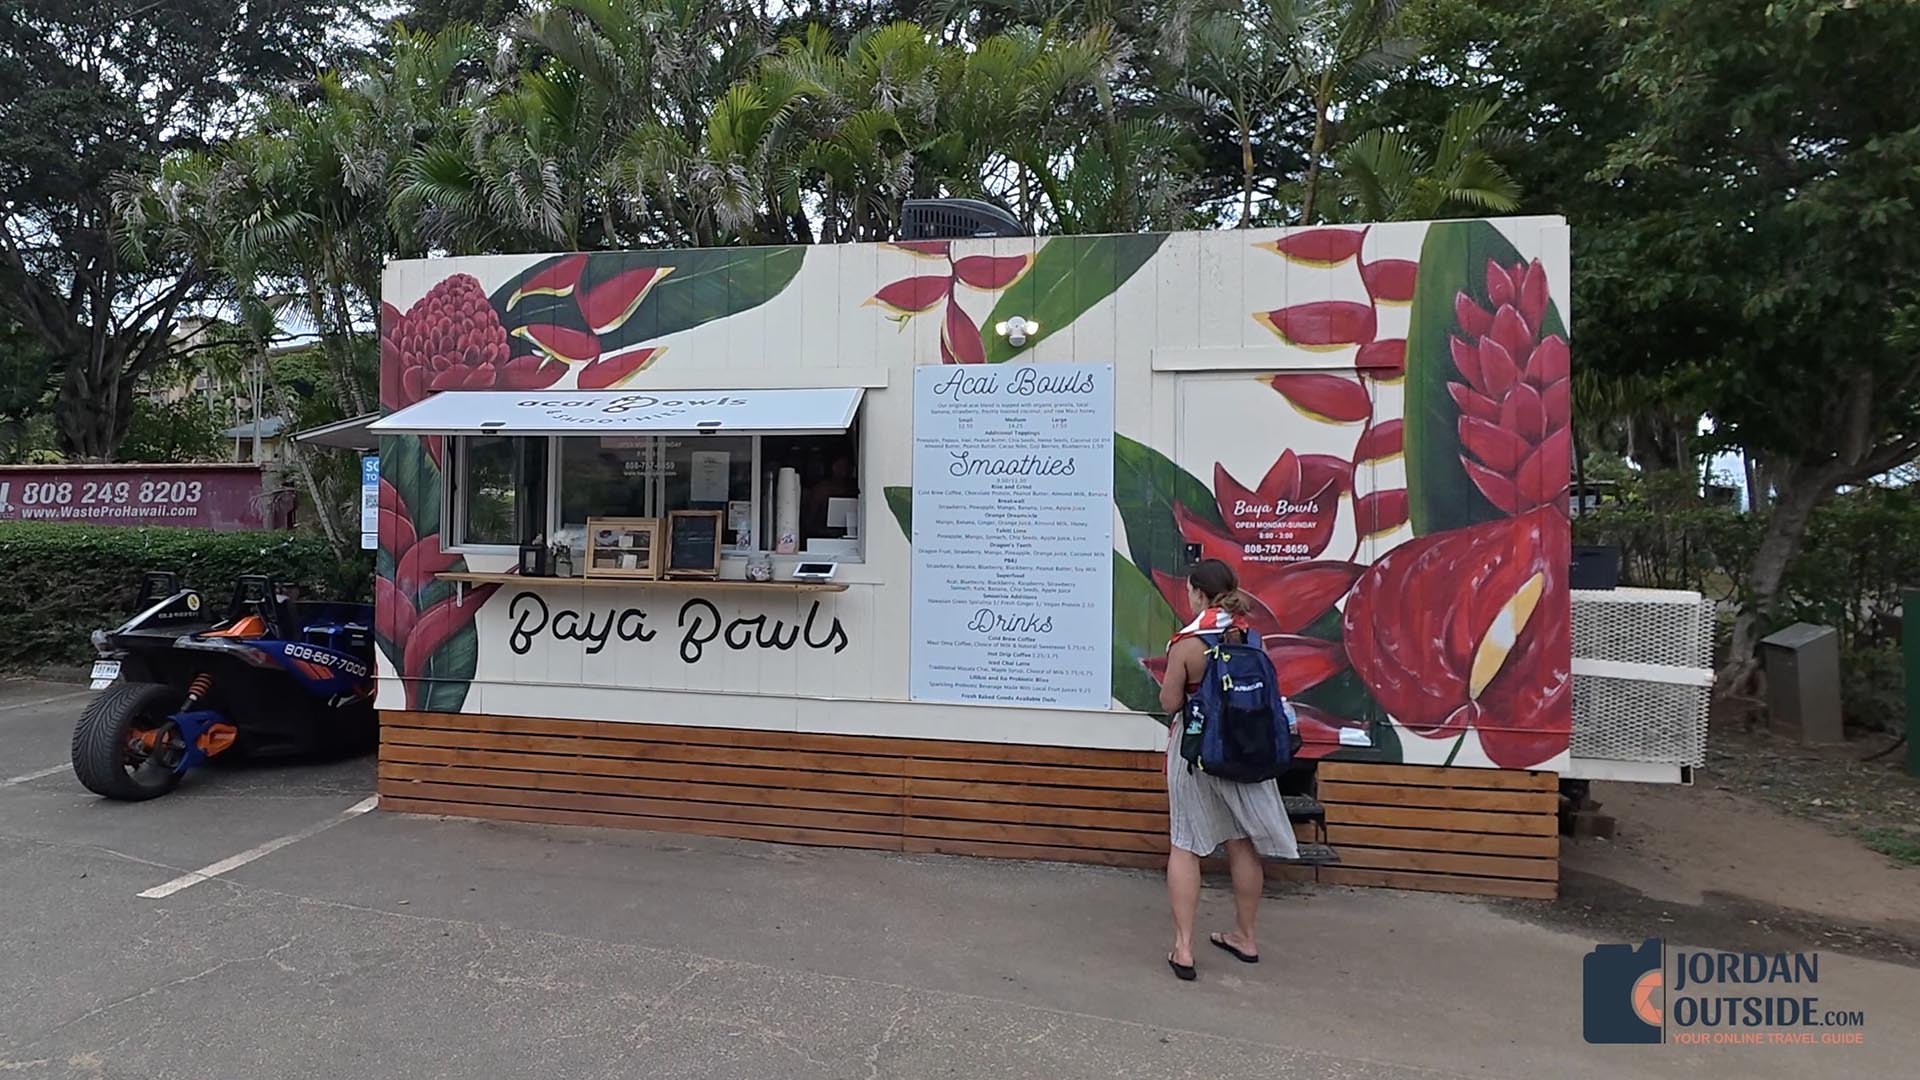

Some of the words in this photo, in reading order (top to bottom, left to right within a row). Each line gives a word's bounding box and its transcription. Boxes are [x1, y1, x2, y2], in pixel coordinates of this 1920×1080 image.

[933, 368, 999, 401] Acai
[1007, 367, 1094, 396] Bowls
[950, 451, 1075, 476] Smoothies
[22, 482, 72, 504] 808
[138, 481, 202, 503] 8203
[22, 505, 198, 518] www.WasteProHawaii.com
[1234, 500, 1272, 518] Baya
[1275, 500, 1318, 516] Bowls
[1244, 545, 1308, 554] 808-757-8659
[509, 591, 656, 654] Baya
[678, 598, 848, 664] Bowls
[968, 608, 1053, 633] Drinks
